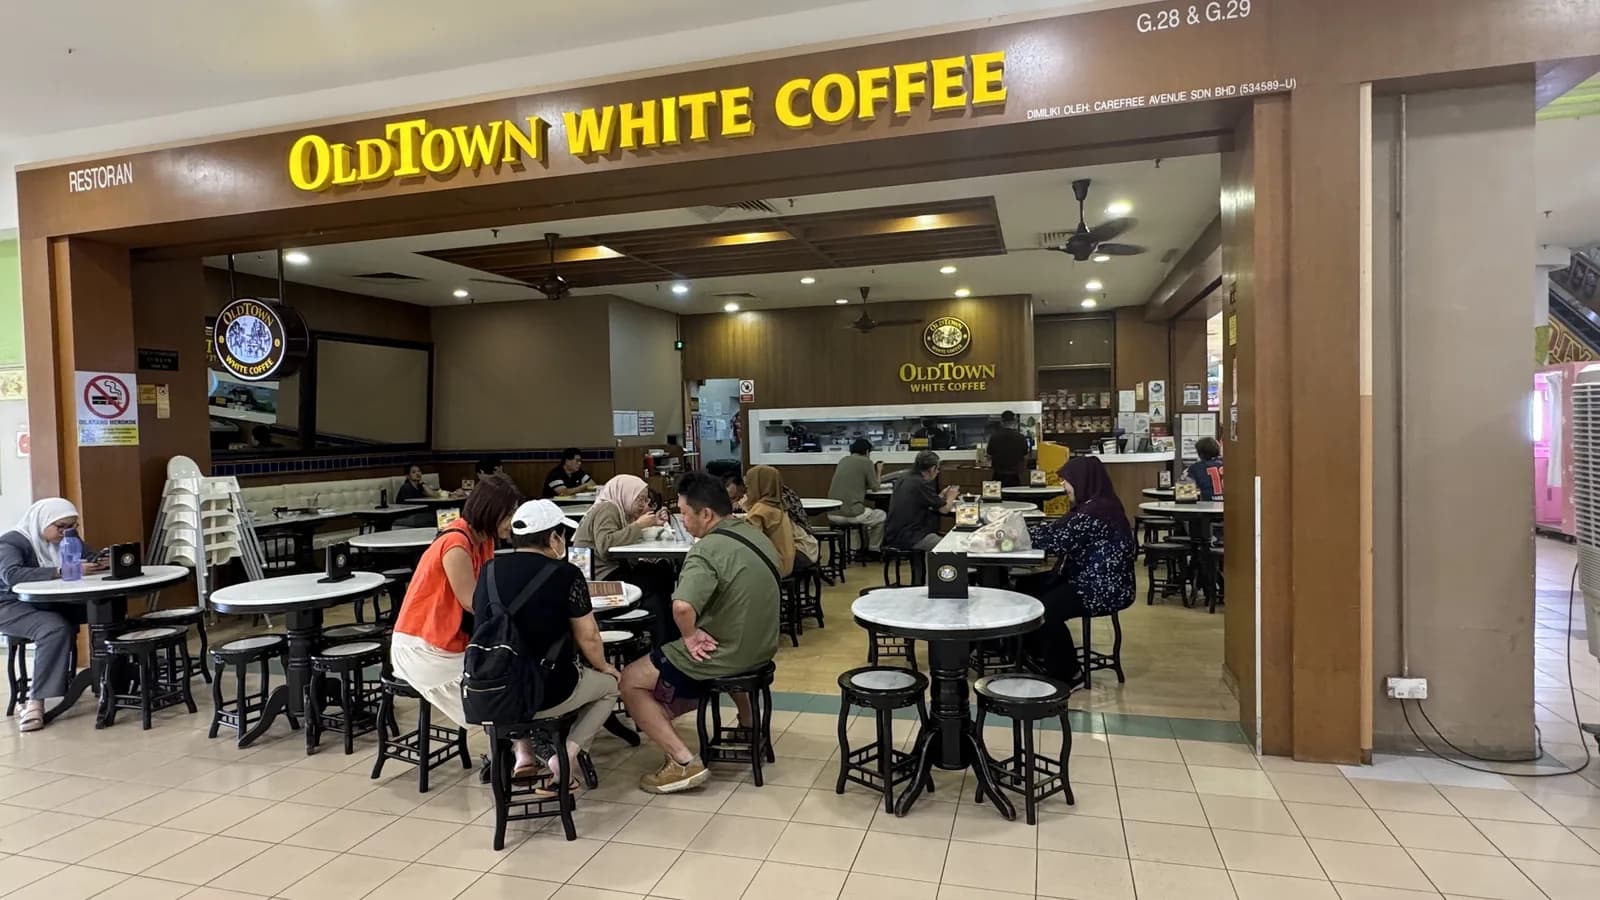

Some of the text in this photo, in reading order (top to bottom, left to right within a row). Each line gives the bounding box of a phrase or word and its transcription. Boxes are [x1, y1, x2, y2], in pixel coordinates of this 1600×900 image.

[1136, 0, 1251, 33] G.28 & G.29
[562, 86, 755, 157] WHITE
[774, 50, 1008, 129] COFFEE
[1026, 106, 1061, 120] DIMILIKI
[1063, 103, 1091, 116] OLEH:
[1093, 95, 1145, 112] CAREFREE
[1148, 90, 1187, 106] AVENUE
[1190, 87, 1212, 101] SDN
[1214, 84, 1236, 98] BHD
[69, 161, 133, 193] RESTORAN
[226, 355, 274, 375] WHITE COFFEE
[911, 381, 986, 392] WHITE COFFEE
